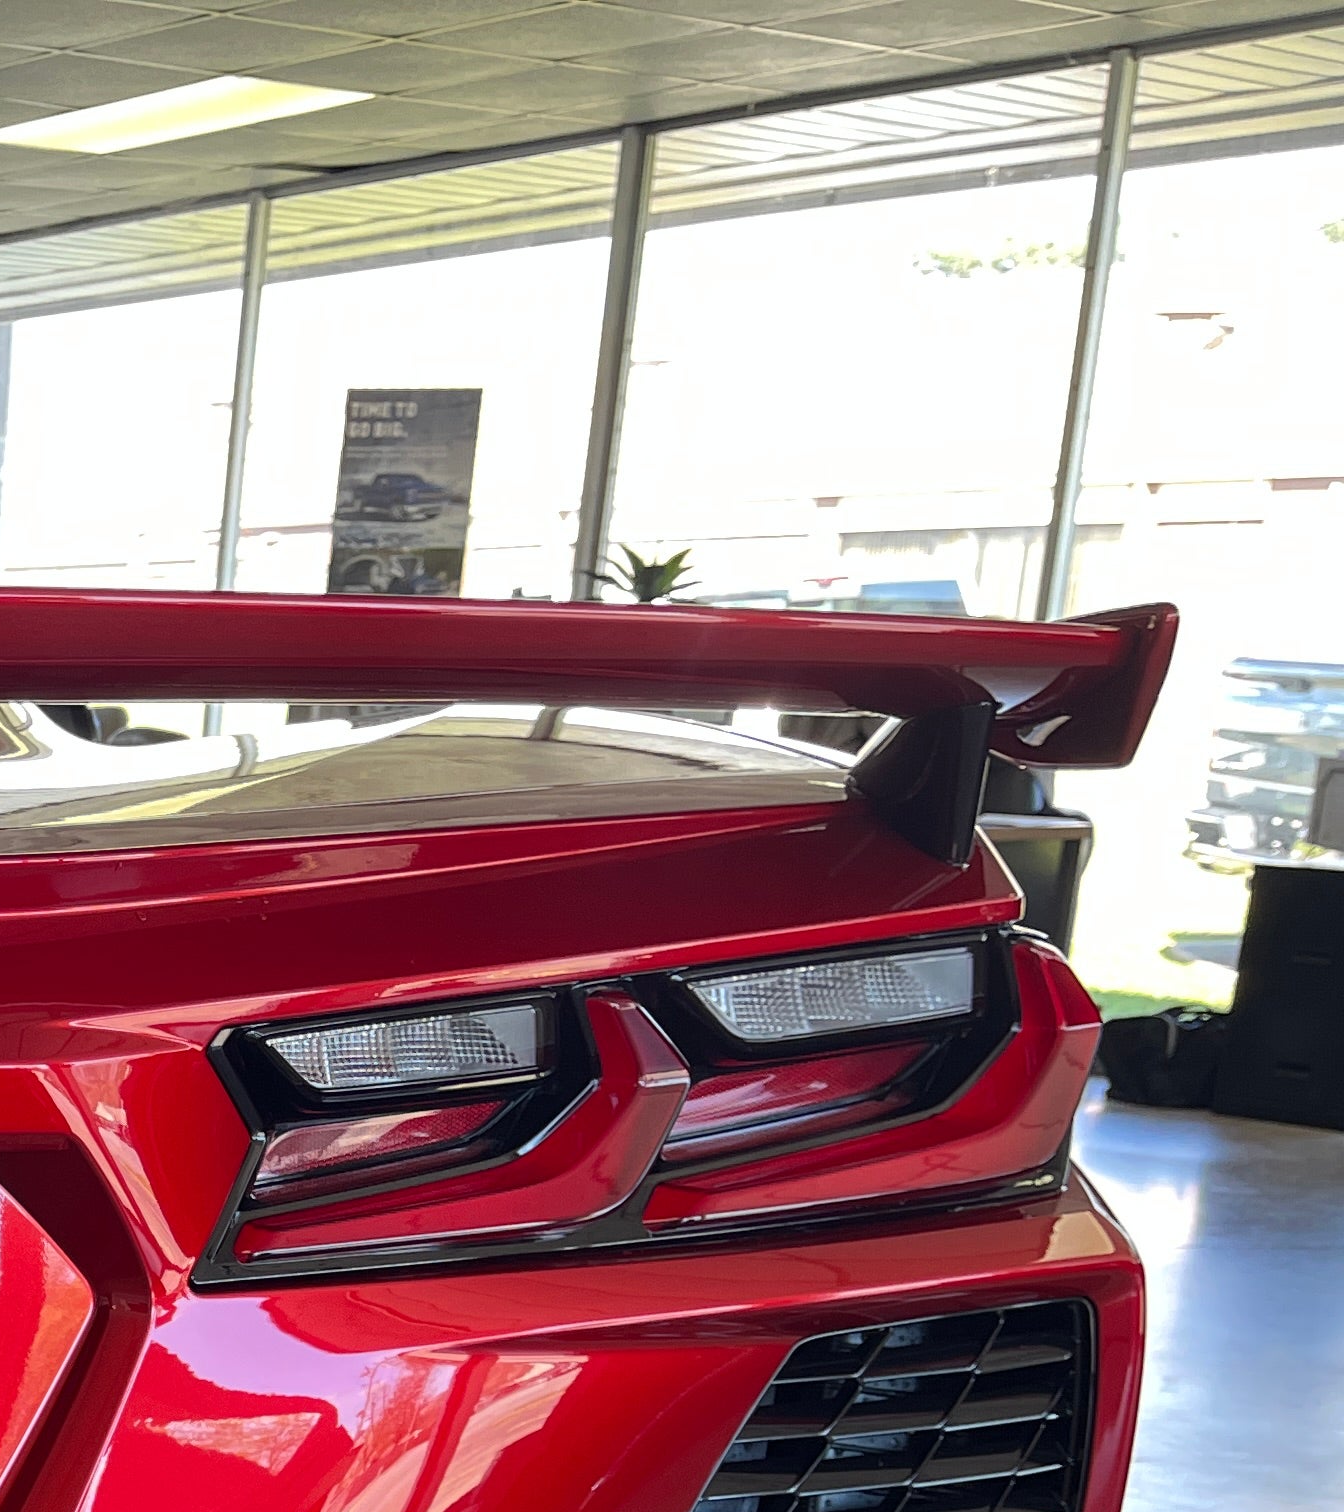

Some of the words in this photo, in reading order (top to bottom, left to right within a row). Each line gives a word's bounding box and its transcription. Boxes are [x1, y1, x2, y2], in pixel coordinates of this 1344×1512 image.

[351, 401, 392, 418] TIME
[395, 401, 418, 418] TO
[349, 421, 370, 438] GO
